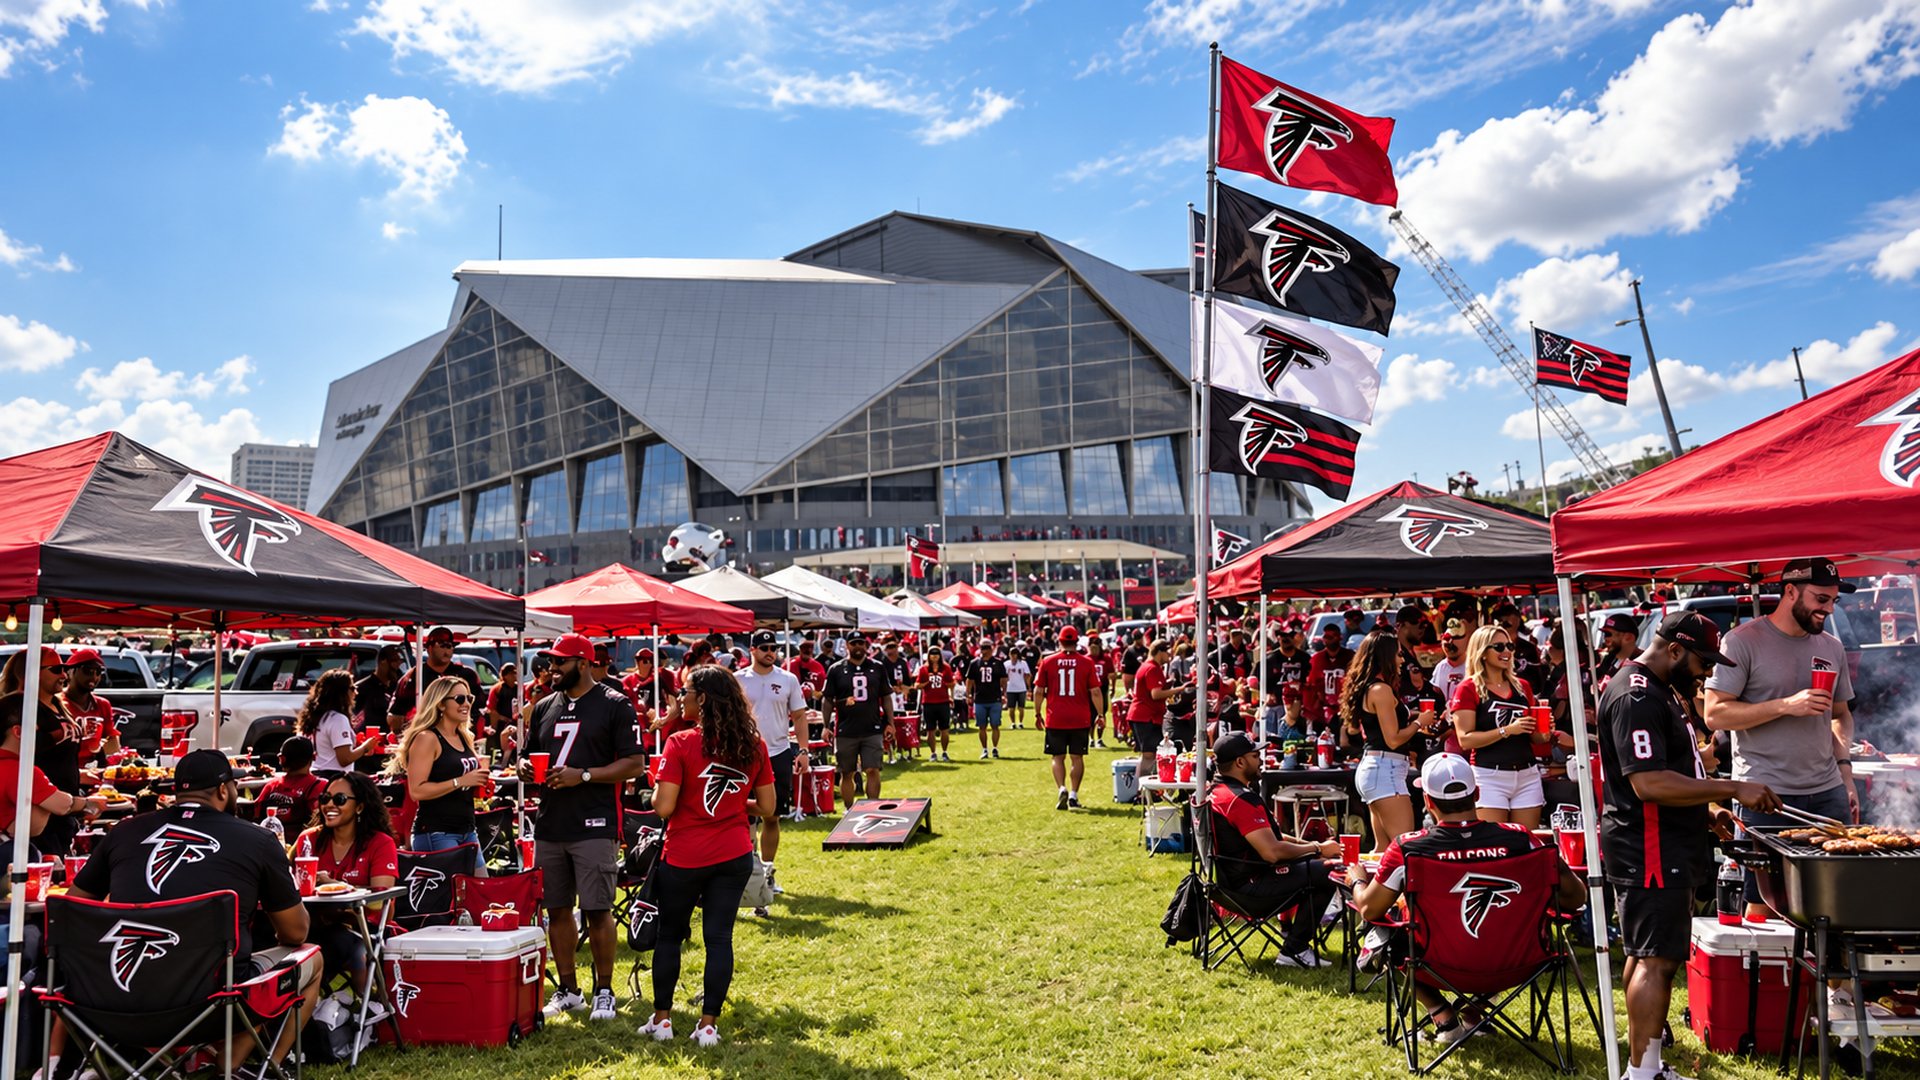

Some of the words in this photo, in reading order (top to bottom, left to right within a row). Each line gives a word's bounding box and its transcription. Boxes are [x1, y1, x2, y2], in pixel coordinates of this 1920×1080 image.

[1057, 658, 1077, 667] PITTS
[852, 675, 868, 703] 8
[1057, 669, 1076, 697] 11
[552, 721, 581, 768] 7
[632, 724, 642, 746] 7
[1631, 728, 1653, 760] 8
